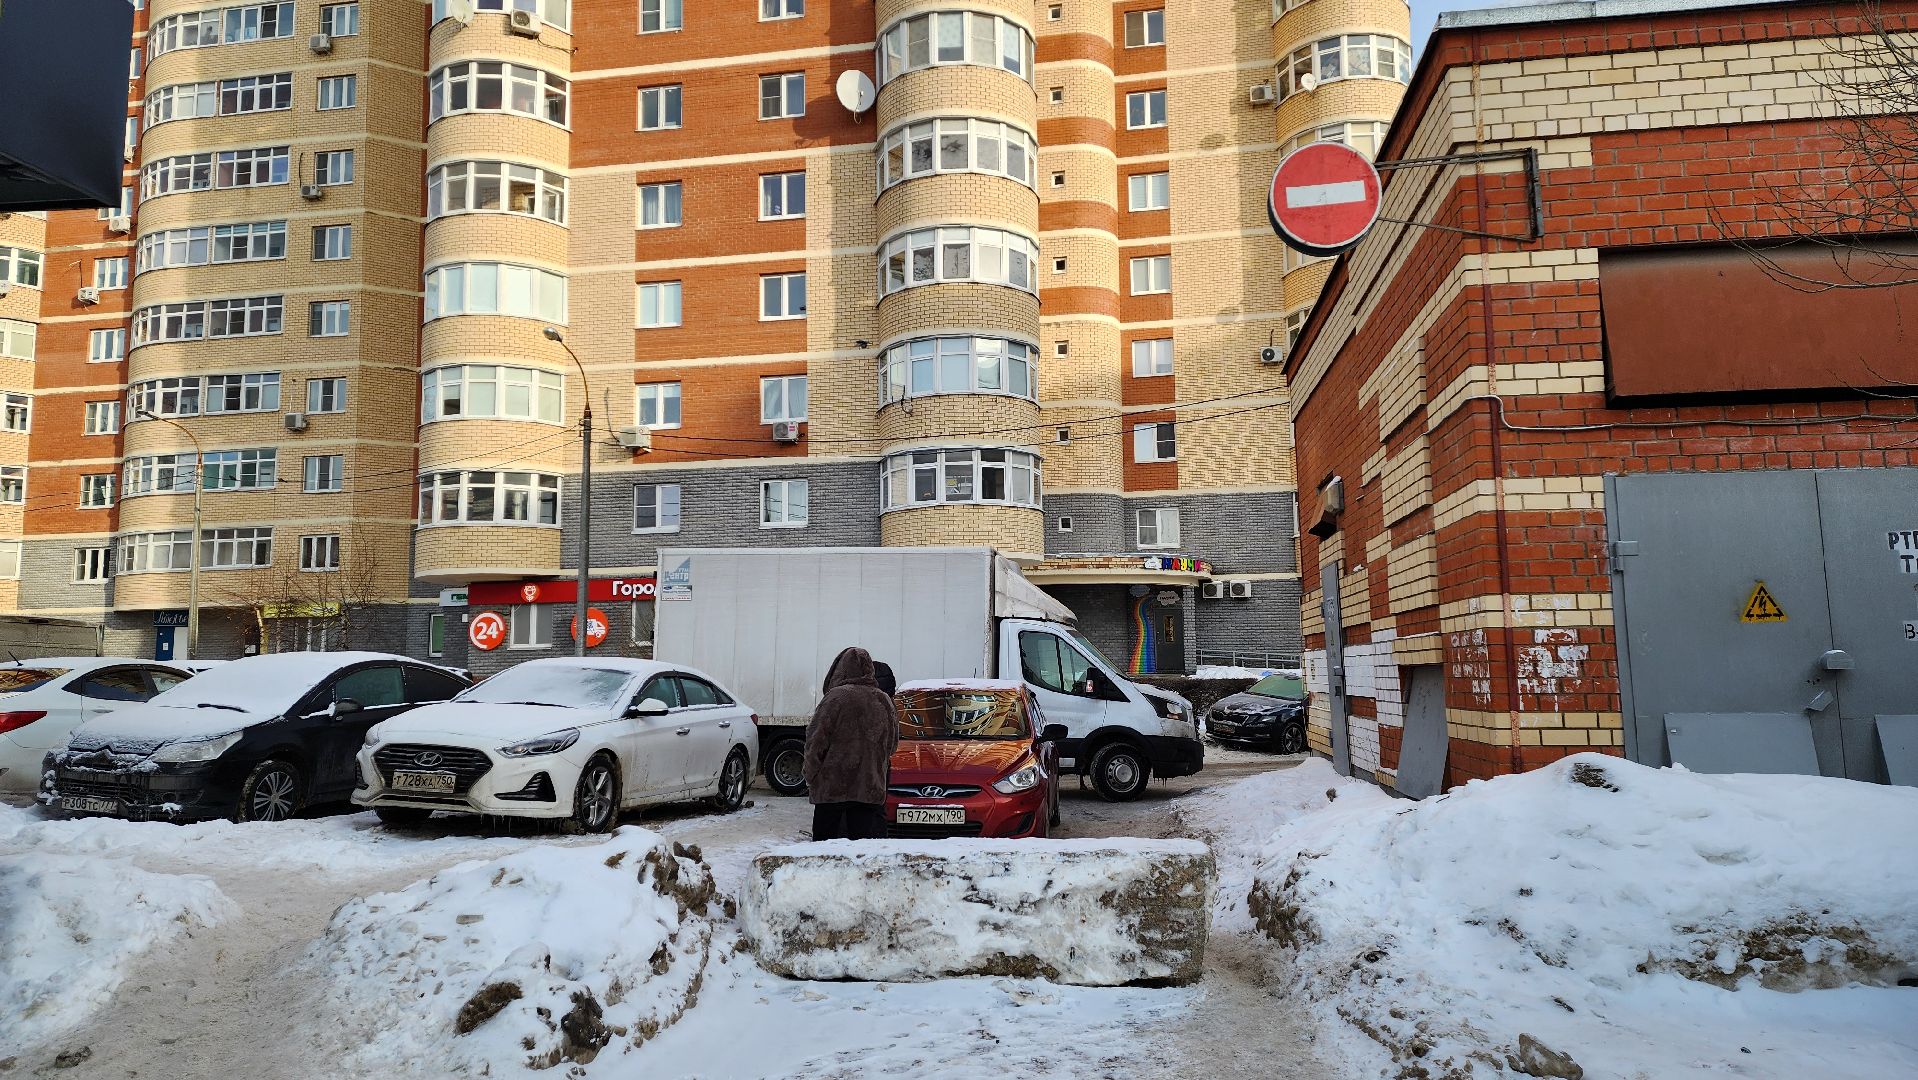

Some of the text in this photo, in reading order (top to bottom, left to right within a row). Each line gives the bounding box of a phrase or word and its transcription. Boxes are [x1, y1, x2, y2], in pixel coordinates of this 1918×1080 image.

[1900, 555, 1918, 573] Т
[612, 580, 657, 599] Горо
[476, 621, 499, 640] 24
[900, 810, 962, 823] Т972МХ 790
